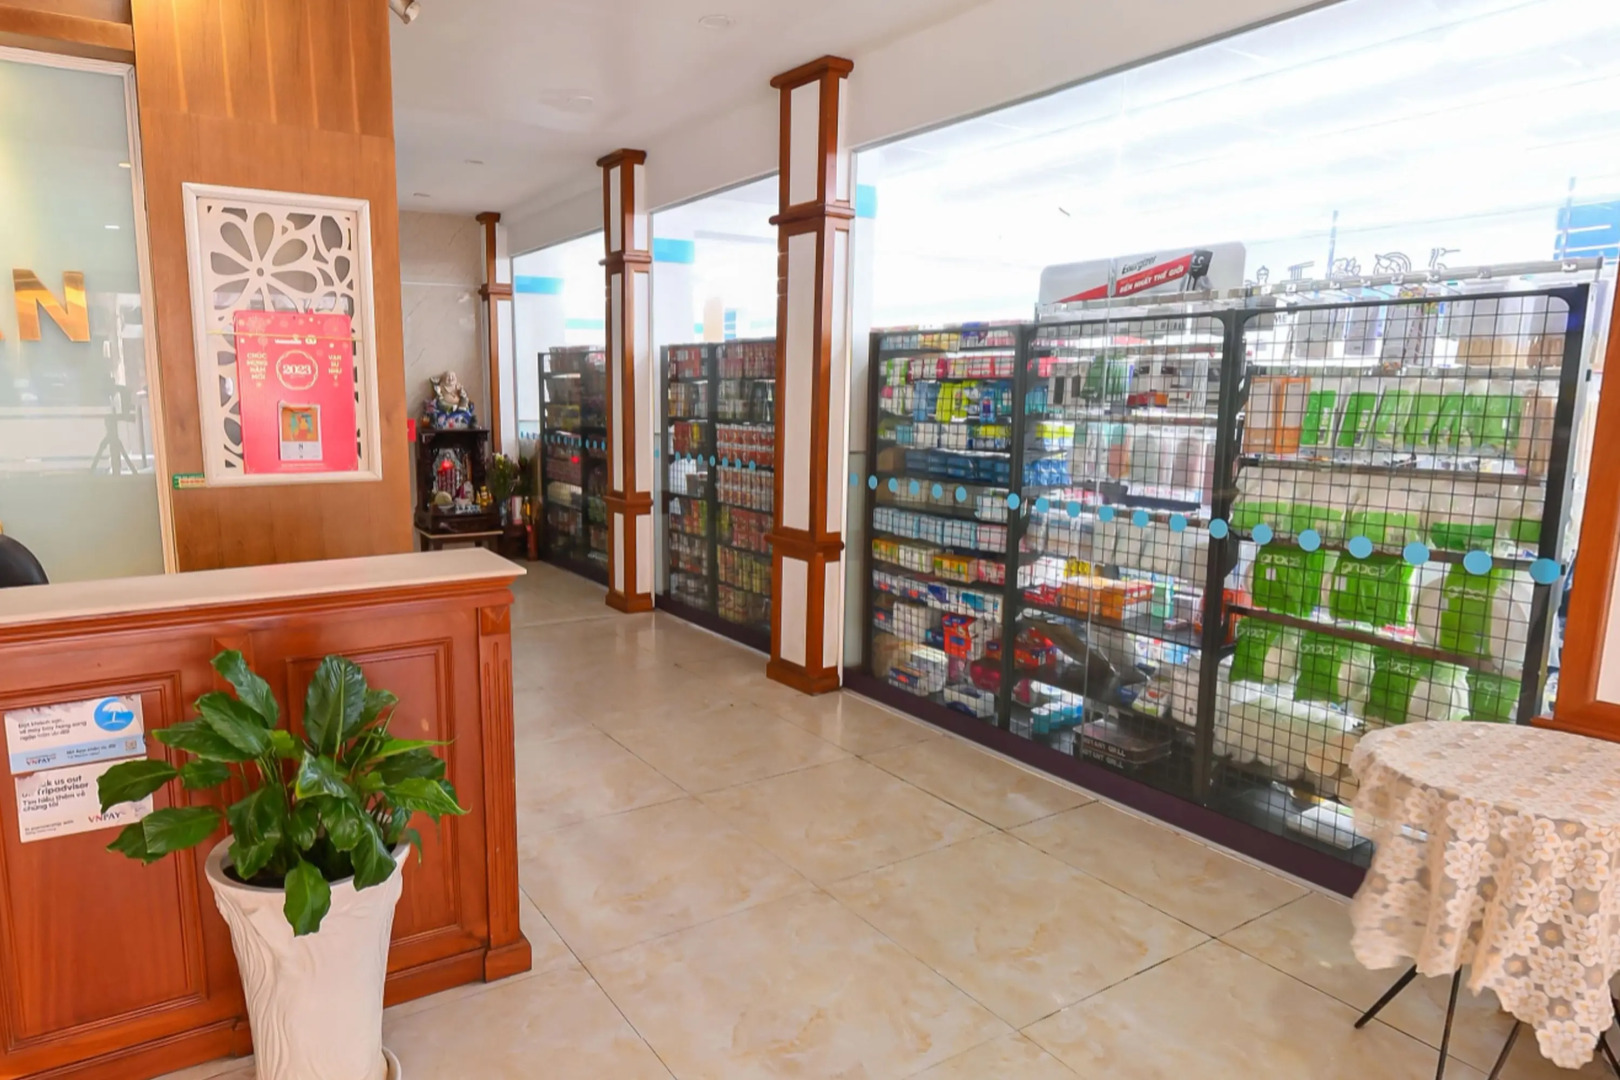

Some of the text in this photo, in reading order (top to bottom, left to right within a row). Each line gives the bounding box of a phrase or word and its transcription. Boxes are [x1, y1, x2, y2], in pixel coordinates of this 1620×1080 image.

[0, 268, 91, 343] N
[282, 364, 312, 375] 2023
[66, 774, 82, 784] out
[87, 811, 121, 823] VNPAY
